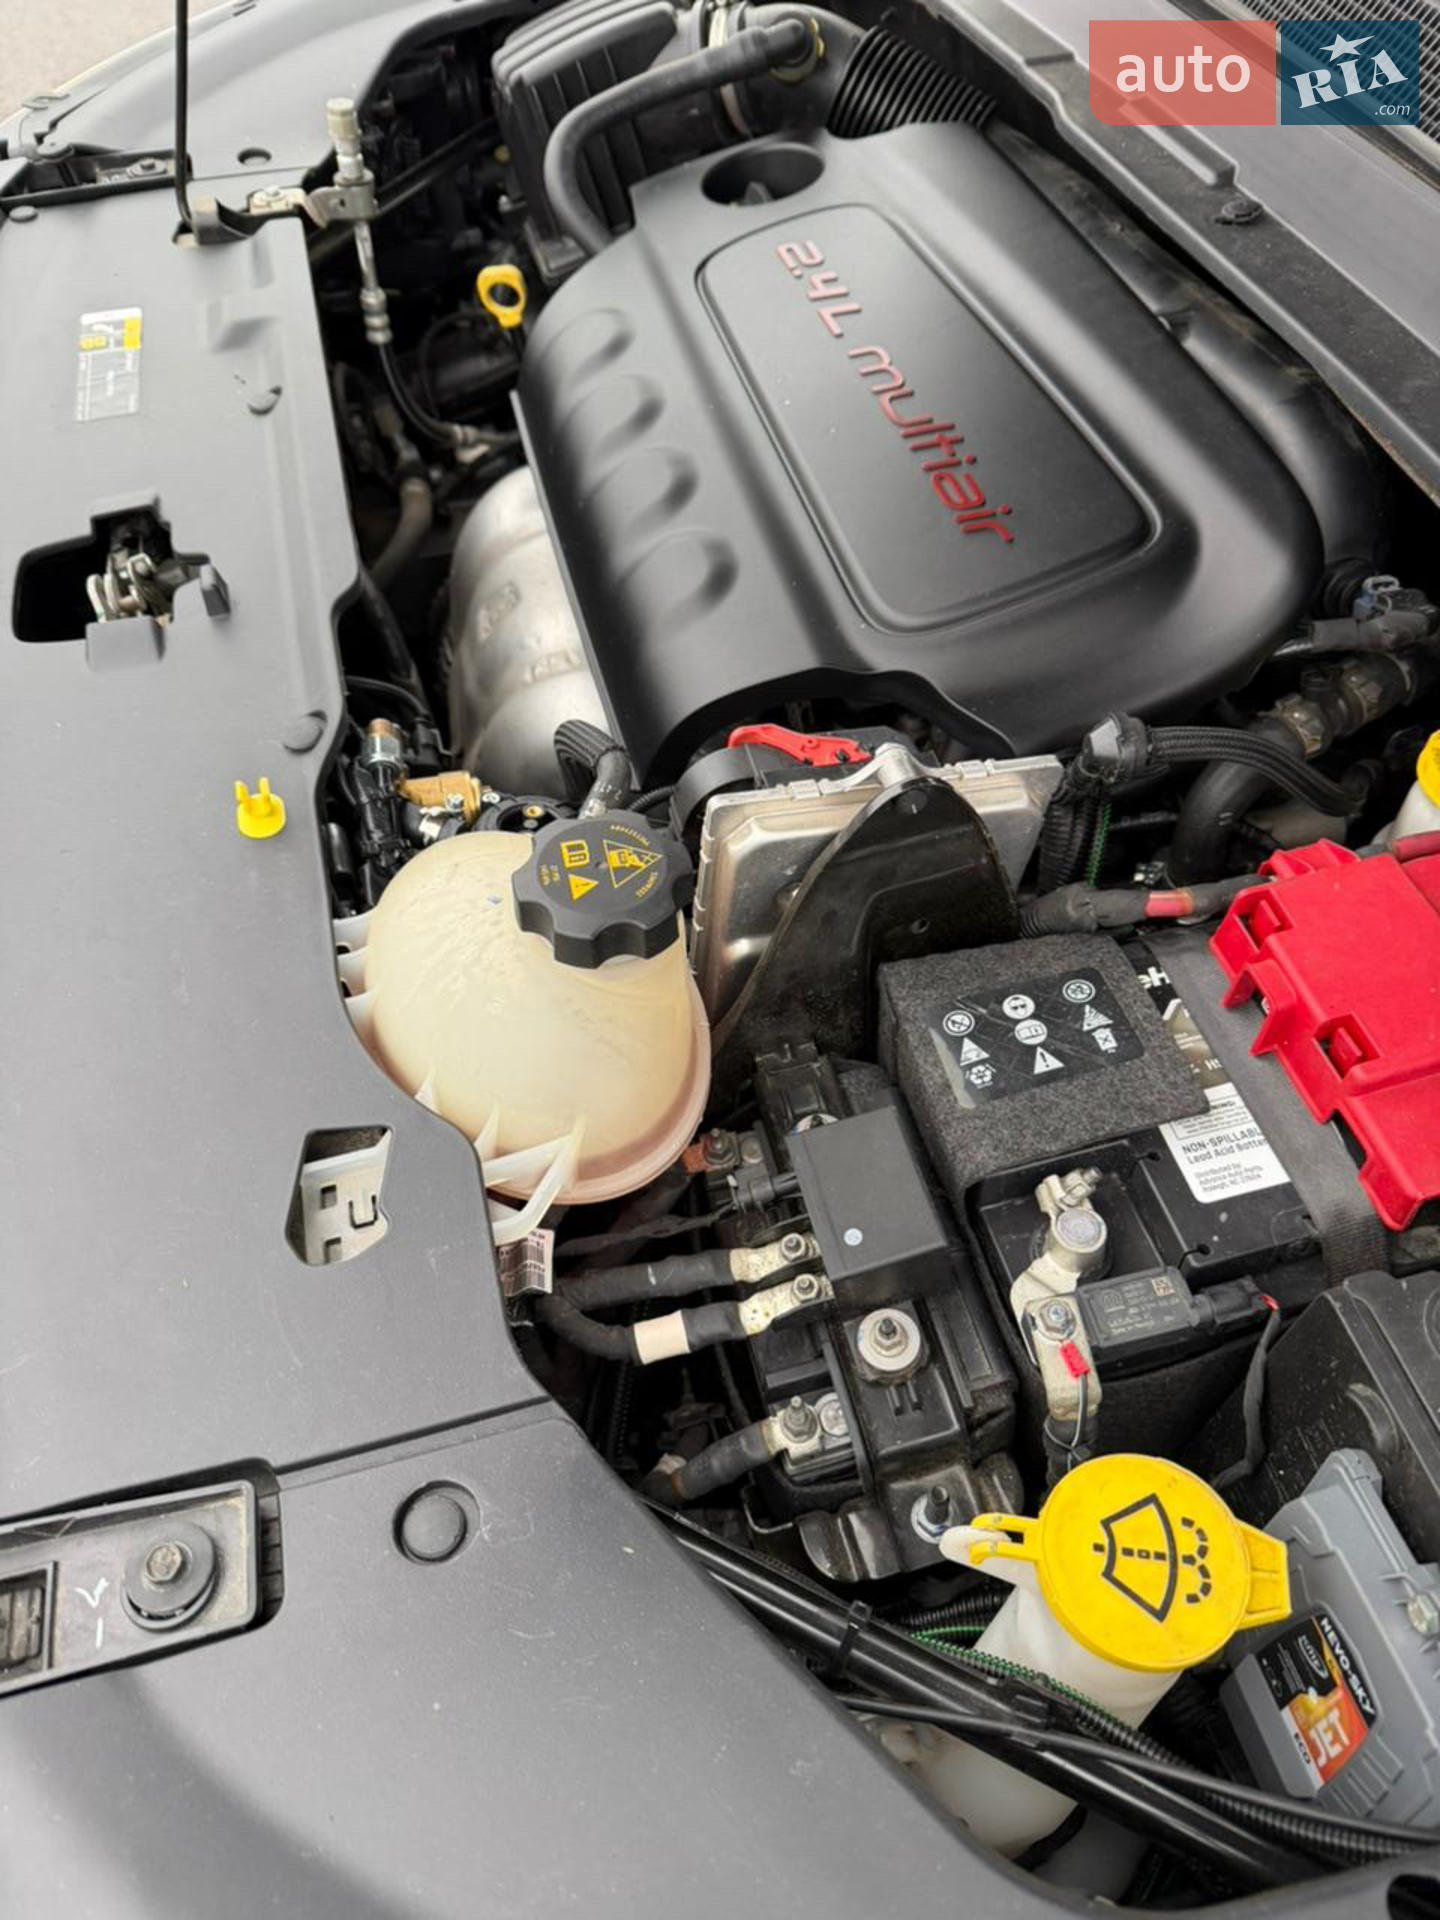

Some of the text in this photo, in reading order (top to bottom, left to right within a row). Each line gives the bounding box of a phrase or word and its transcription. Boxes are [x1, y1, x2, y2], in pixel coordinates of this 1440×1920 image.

[776, 239, 1014, 543] 2.4L multiair
[1181, 1128, 1261, 1153] NON-SPILLABL
[1187, 1138, 1267, 1163] Lead Acid Batter
[1320, 1617, 1375, 1715] NEVO-SKY
[1293, 1732, 1311, 1764] ECO
[1317, 1707, 1350, 1768] JET
